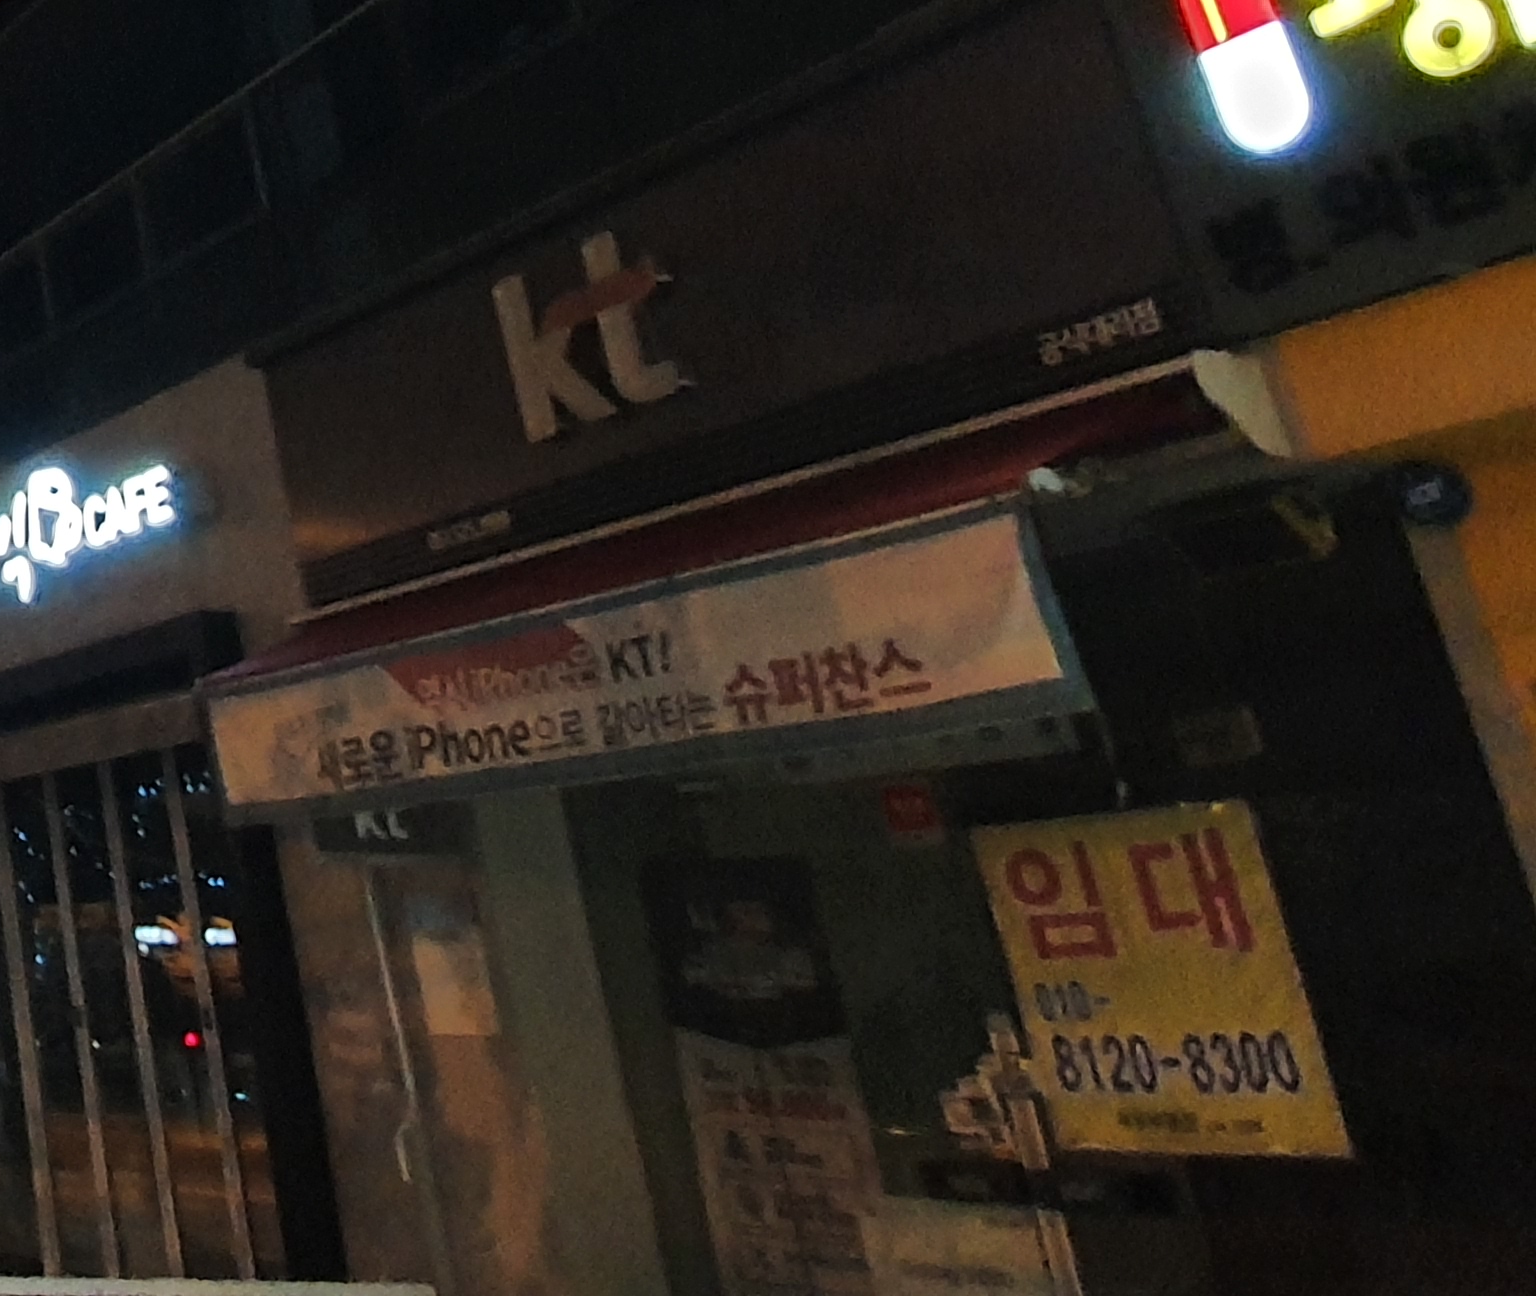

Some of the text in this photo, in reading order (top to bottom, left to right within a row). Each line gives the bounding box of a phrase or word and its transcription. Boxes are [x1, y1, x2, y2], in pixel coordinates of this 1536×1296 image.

[491, 230, 680, 444] kt
[606, 629, 674, 684] KT!
[1004, 826, 1256, 962] 임대
[1050, 1030, 1304, 1094] 8120-8300
